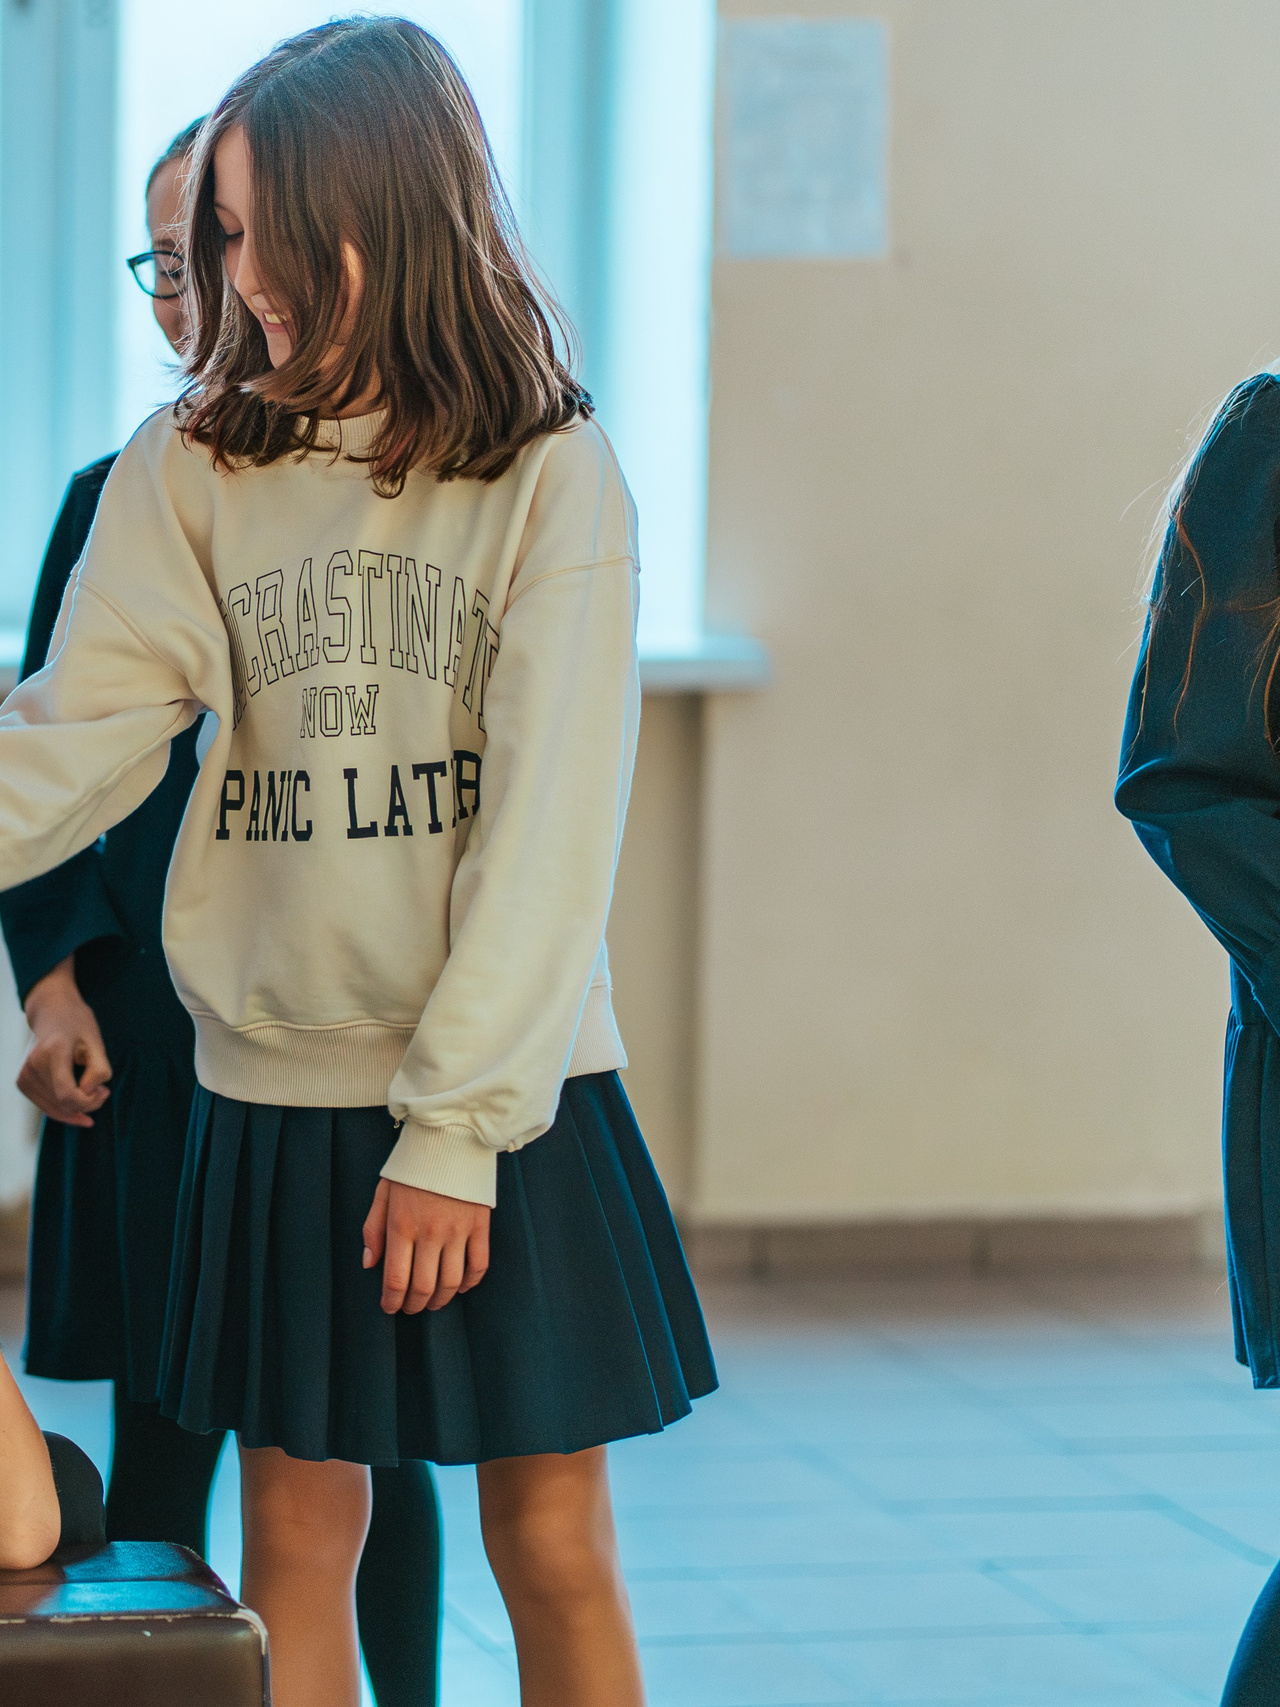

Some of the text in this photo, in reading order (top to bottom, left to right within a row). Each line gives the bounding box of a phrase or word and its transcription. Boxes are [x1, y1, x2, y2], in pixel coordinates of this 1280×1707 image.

[299, 684, 380, 739] NOW
[215, 749, 482, 842] PANIC LATR
